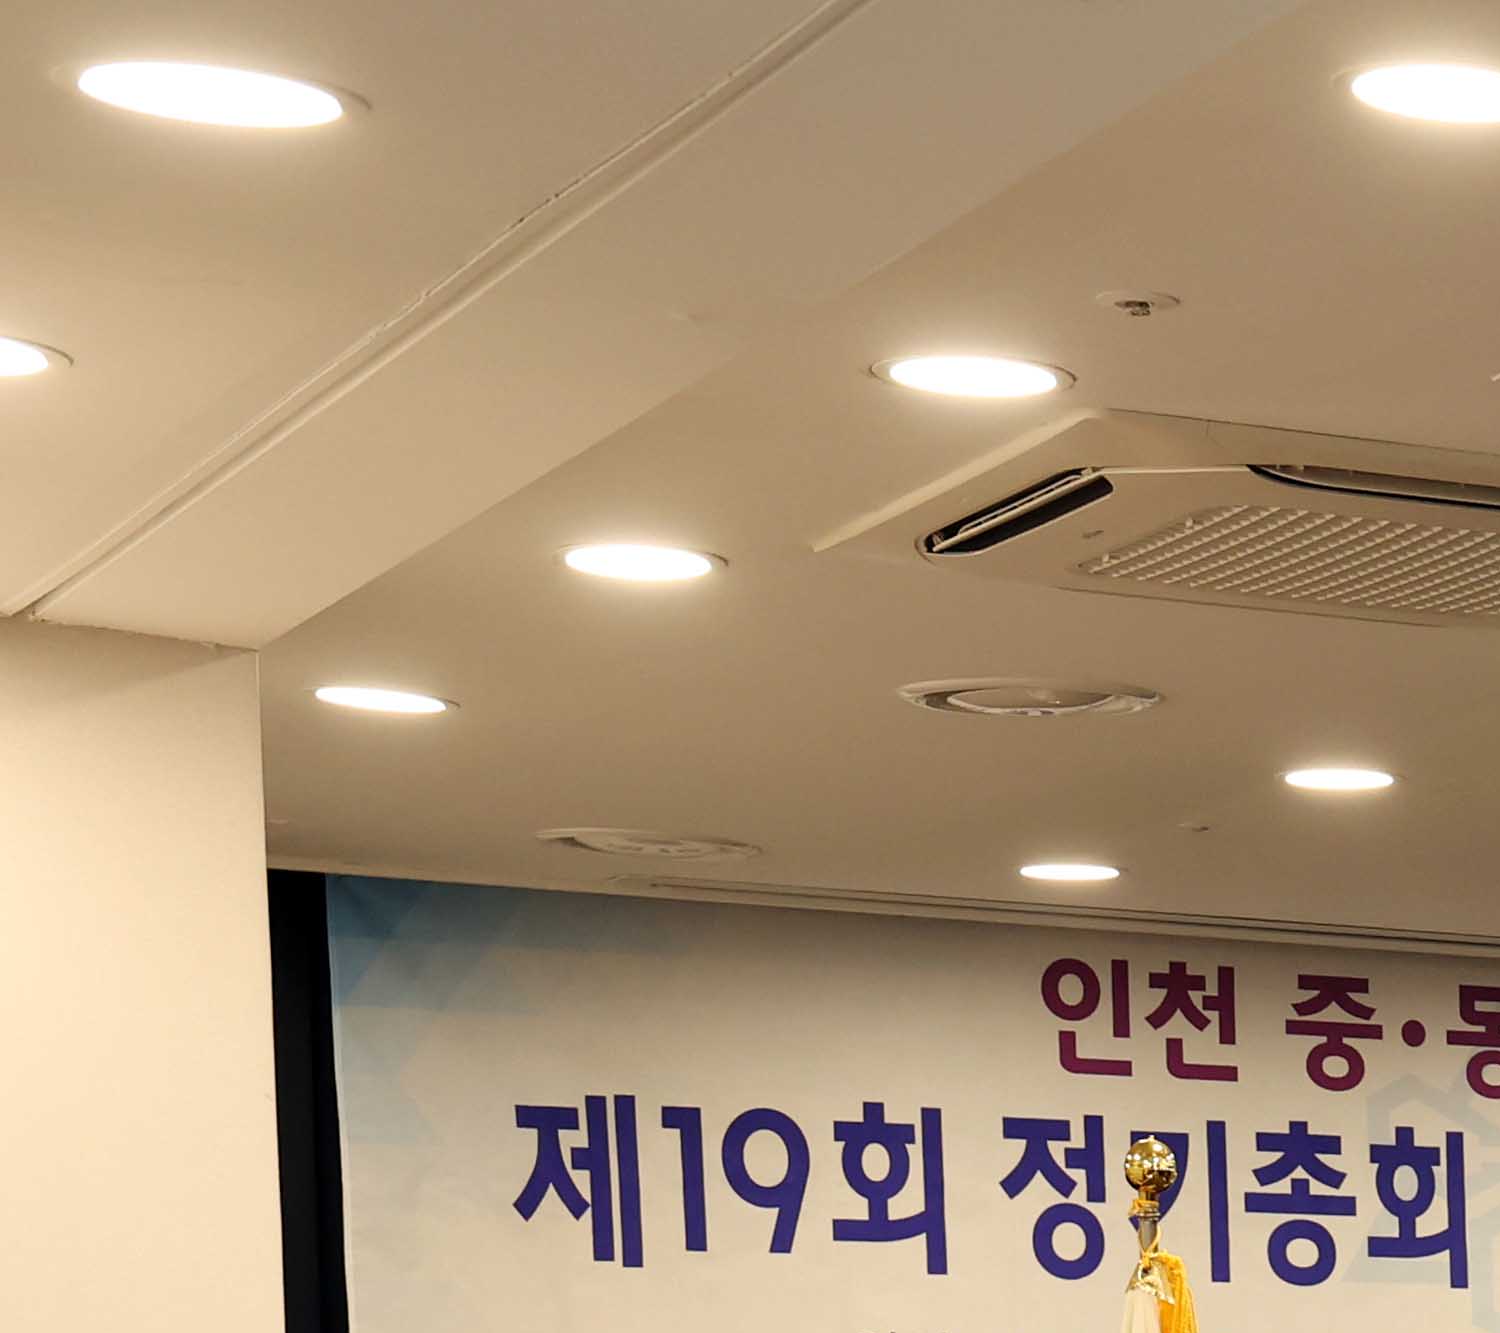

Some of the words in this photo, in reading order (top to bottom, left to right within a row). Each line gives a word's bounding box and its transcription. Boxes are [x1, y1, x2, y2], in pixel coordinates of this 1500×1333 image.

[1039, 956, 1240, 1082] 인천
[513, 1093, 949, 1276] 제19회
[998, 1114, 1470, 1289] 정기총회
